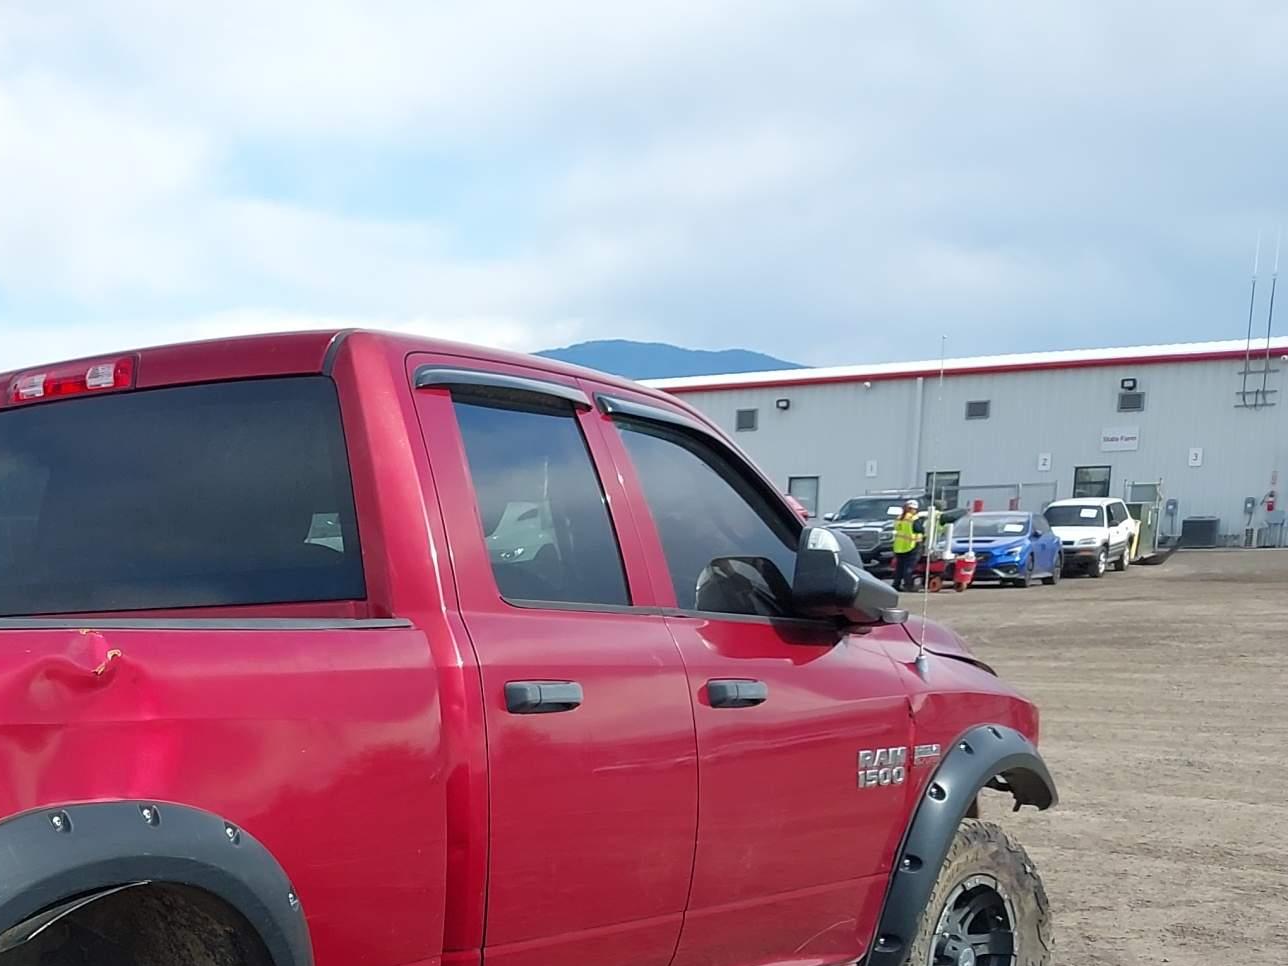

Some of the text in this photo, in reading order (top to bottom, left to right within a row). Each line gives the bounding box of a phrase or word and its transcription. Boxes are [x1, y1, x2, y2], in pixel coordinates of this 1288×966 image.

[1041, 458, 1048, 467] 2
[1192, 452, 1199, 462] 3
[858, 746, 907, 768] RAM
[858, 766, 905, 788] 1500
